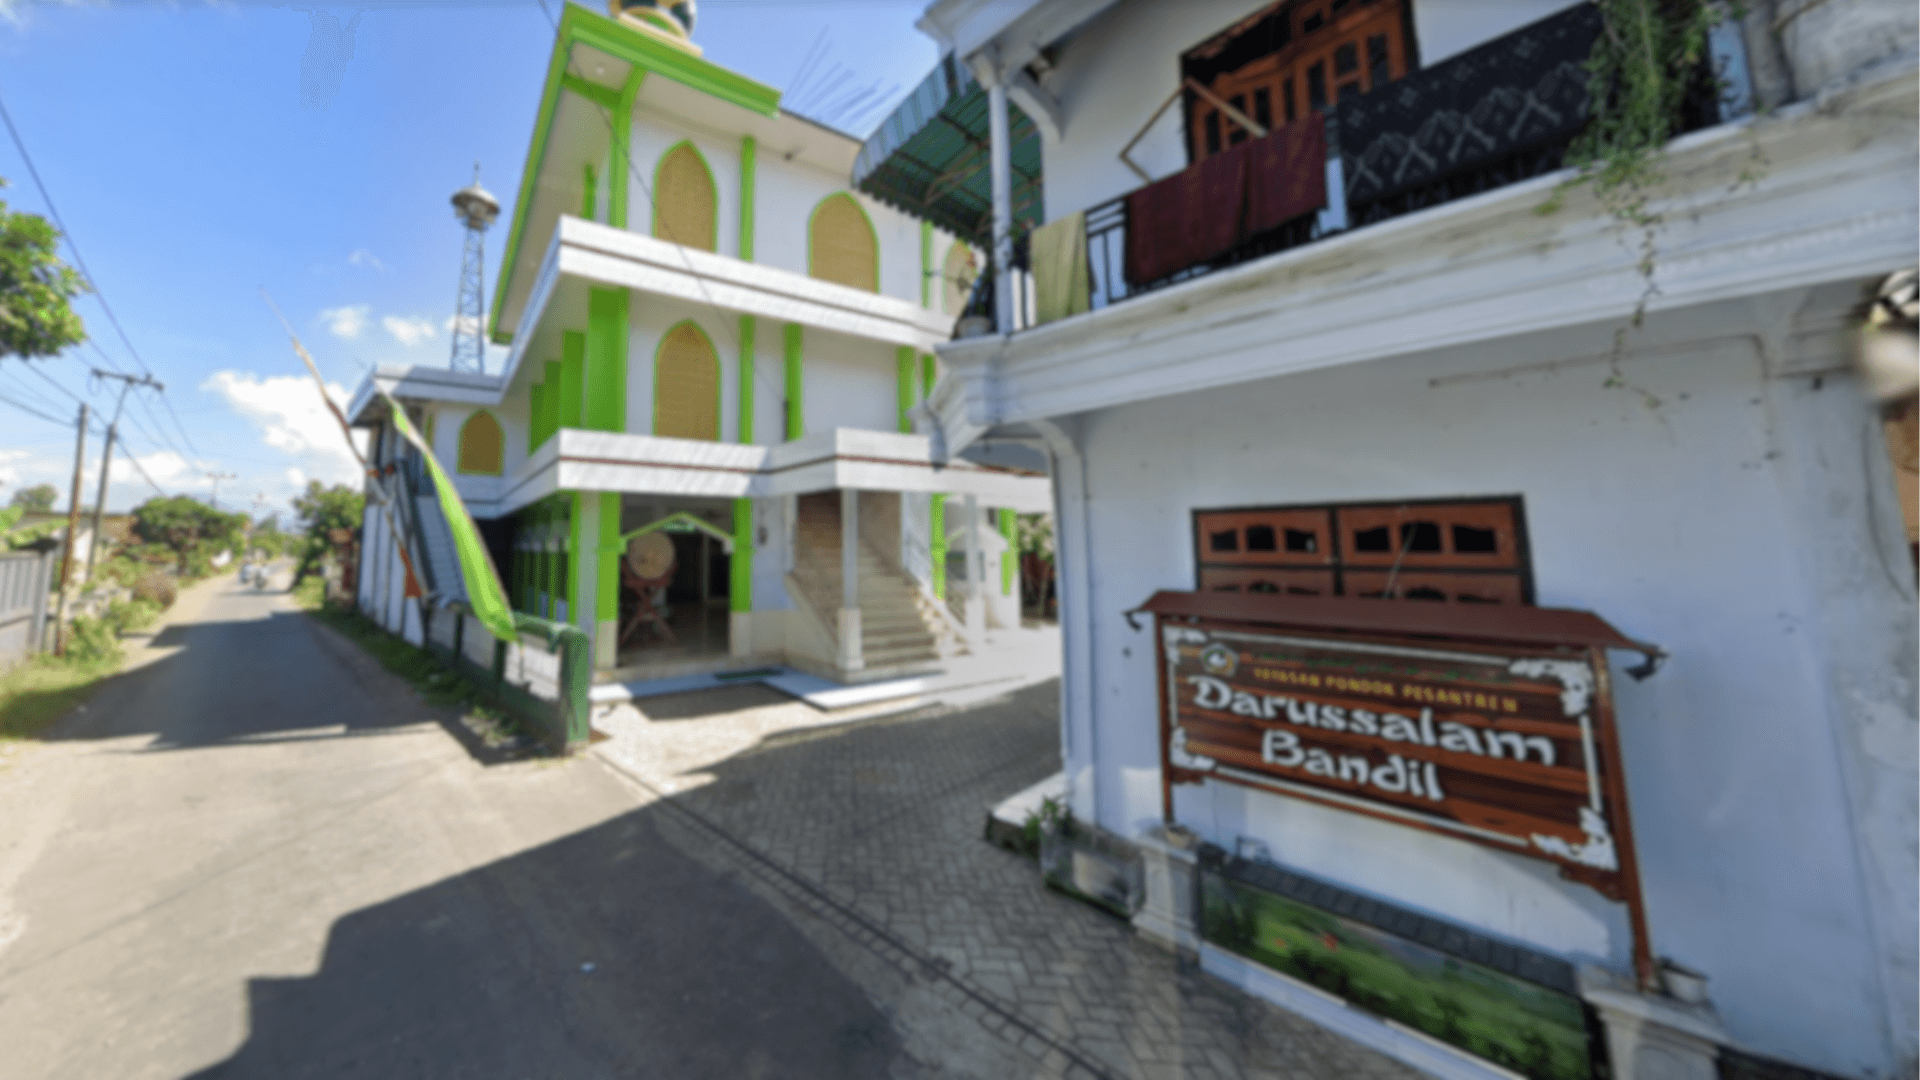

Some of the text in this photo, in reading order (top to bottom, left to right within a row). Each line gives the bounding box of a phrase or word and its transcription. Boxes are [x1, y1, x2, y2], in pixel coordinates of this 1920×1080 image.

[1188, 674, 1557, 767] Darussalam
[1325, 675, 1395, 696] PONDOK
[1402, 684, 1518, 712] PESANTREN
[1261, 728, 1445, 801] Bandil
